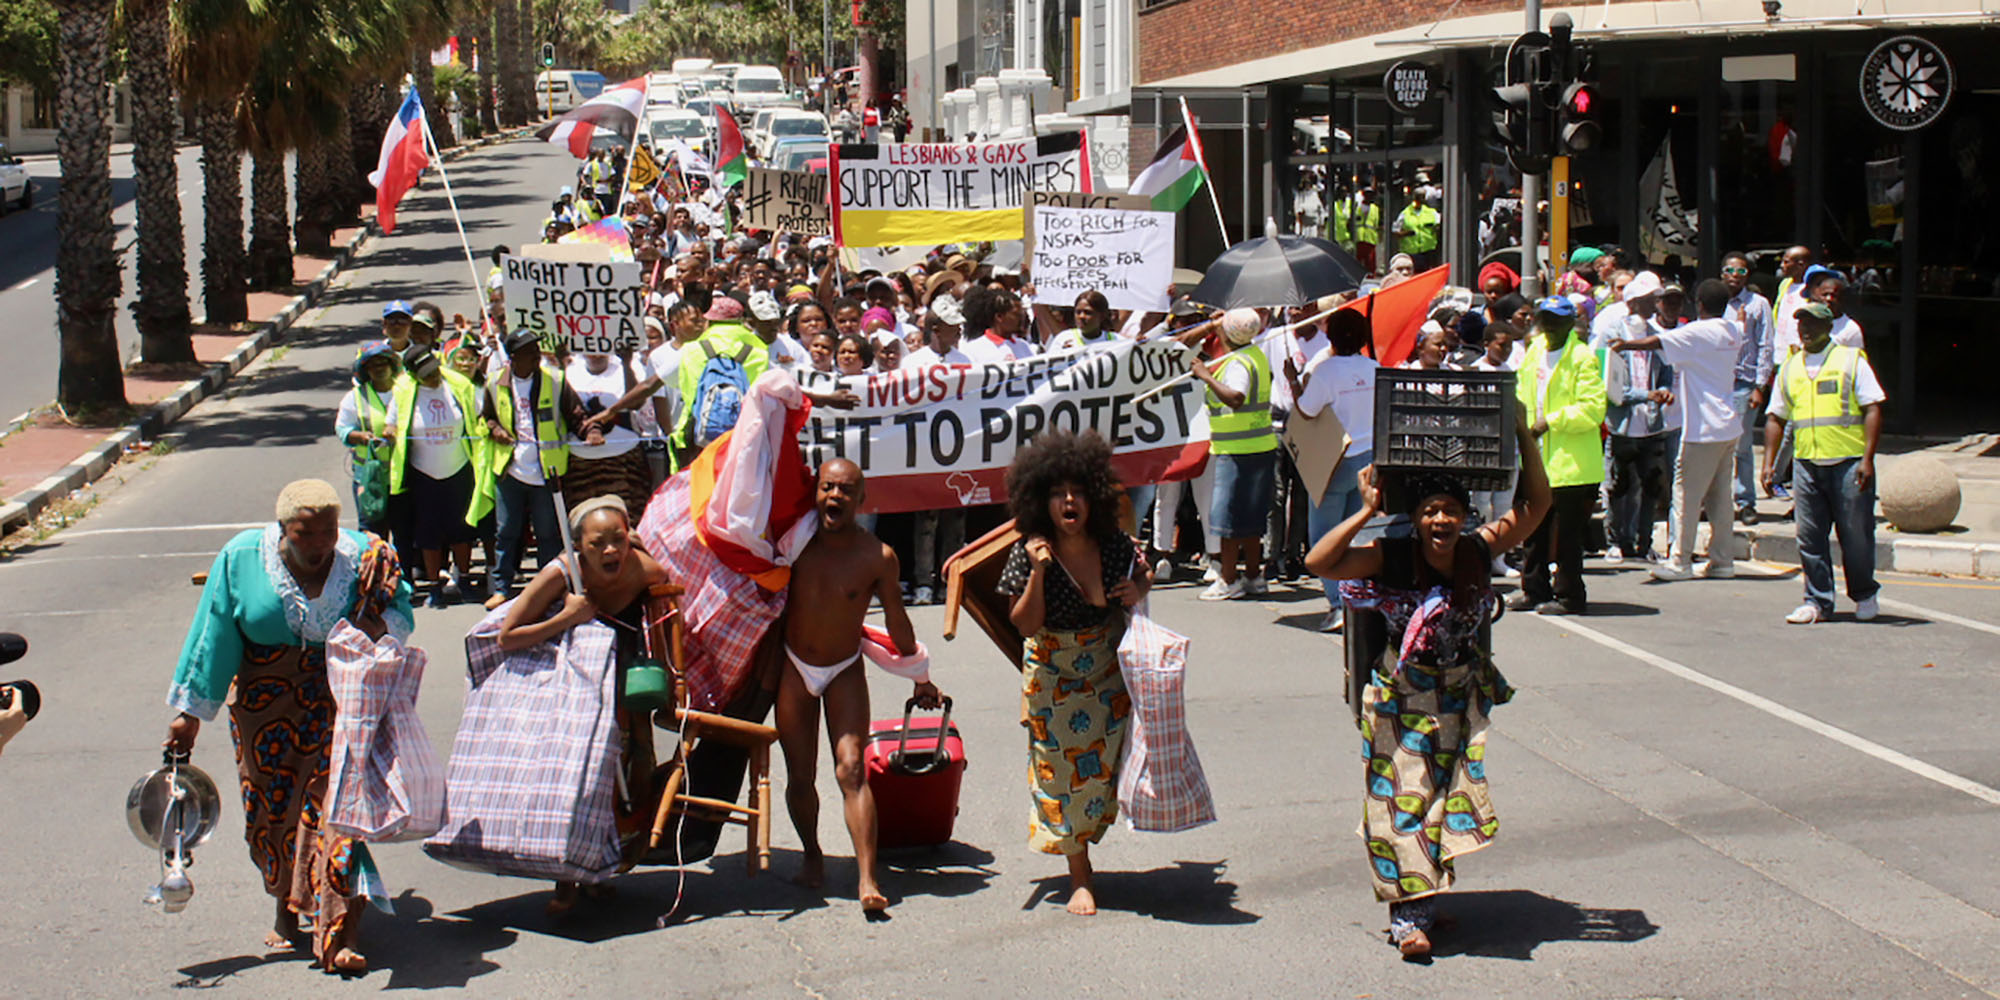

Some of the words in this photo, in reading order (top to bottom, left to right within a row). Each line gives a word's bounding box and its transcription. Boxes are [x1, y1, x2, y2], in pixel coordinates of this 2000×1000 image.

[1395, 69, 1426, 80] DEATH
[1394, 80, 1429, 91] BEFORE
[1397, 91, 1426, 102] DECAF
[888, 144, 961, 165] LESBIANS
[967, 146, 978, 164] &
[983, 143, 1028, 164] GAYS
[780, 171, 828, 204] RIGHT
[840, 167, 931, 208] SUPPORT
[942, 169, 980, 209] THE
[991, 158, 1075, 209] MINERS
[1558, 182, 1566, 196] 3
[786, 201, 812, 217] TO
[777, 214, 825, 235] PROTEST
[1080, 212, 1125, 232] RICH
[1133, 214, 1158, 229] FOR
[1042, 233, 1094, 250] NSFAS
[1068, 254, 1109, 267] POOR
[1117, 252, 1144, 265] FOR
[508, 259, 568, 287] RIGHT
[577, 262, 613, 287] TO
[533, 286, 641, 317] PROTEST
[515, 308, 546, 330] IS
[556, 314, 611, 337] NOT
[619, 317, 636, 338] A
[531, 331, 640, 353] RIVLEDGE
[867, 363, 972, 407] MUST
[981, 350, 1118, 399] DEFEND
[1128, 346, 1187, 384] OUR
[893, 408, 965, 468] TO
[980, 382, 1194, 462] PROTEST
